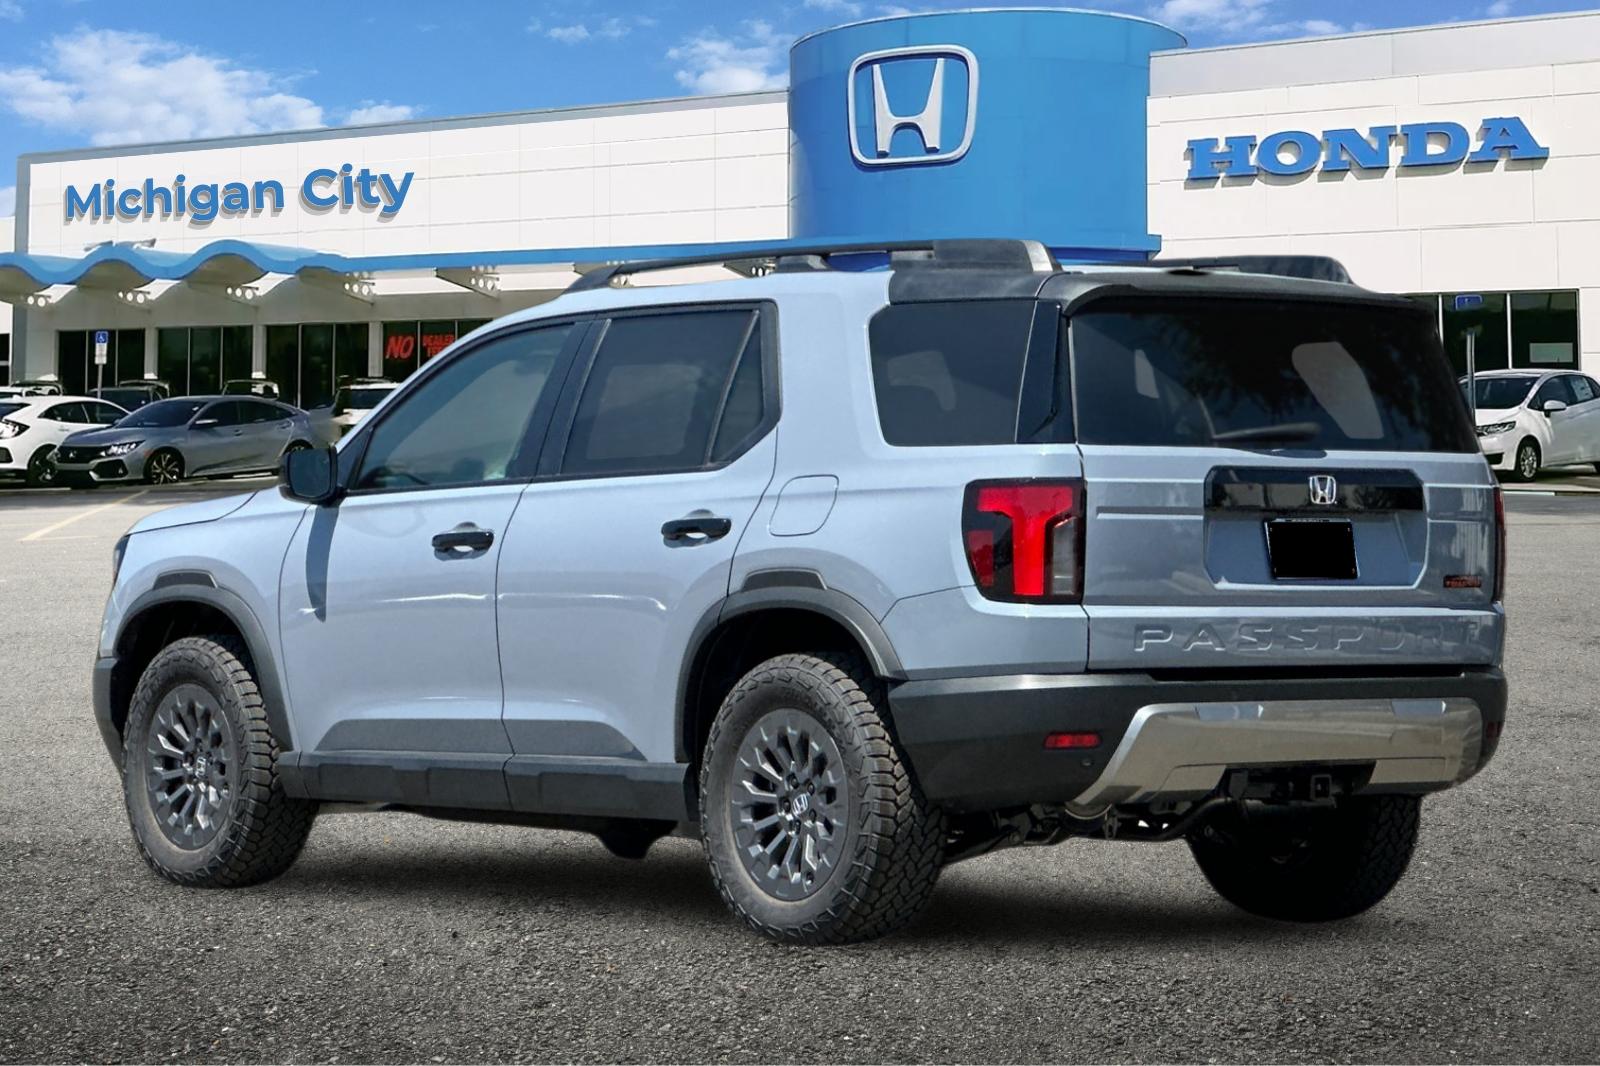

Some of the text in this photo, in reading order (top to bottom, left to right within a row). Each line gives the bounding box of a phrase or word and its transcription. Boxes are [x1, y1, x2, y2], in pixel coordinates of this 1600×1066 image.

[1186, 116, 1549, 183] HONDA
[65, 163, 414, 222] Michigan City
[385, 335, 415, 359] NO
